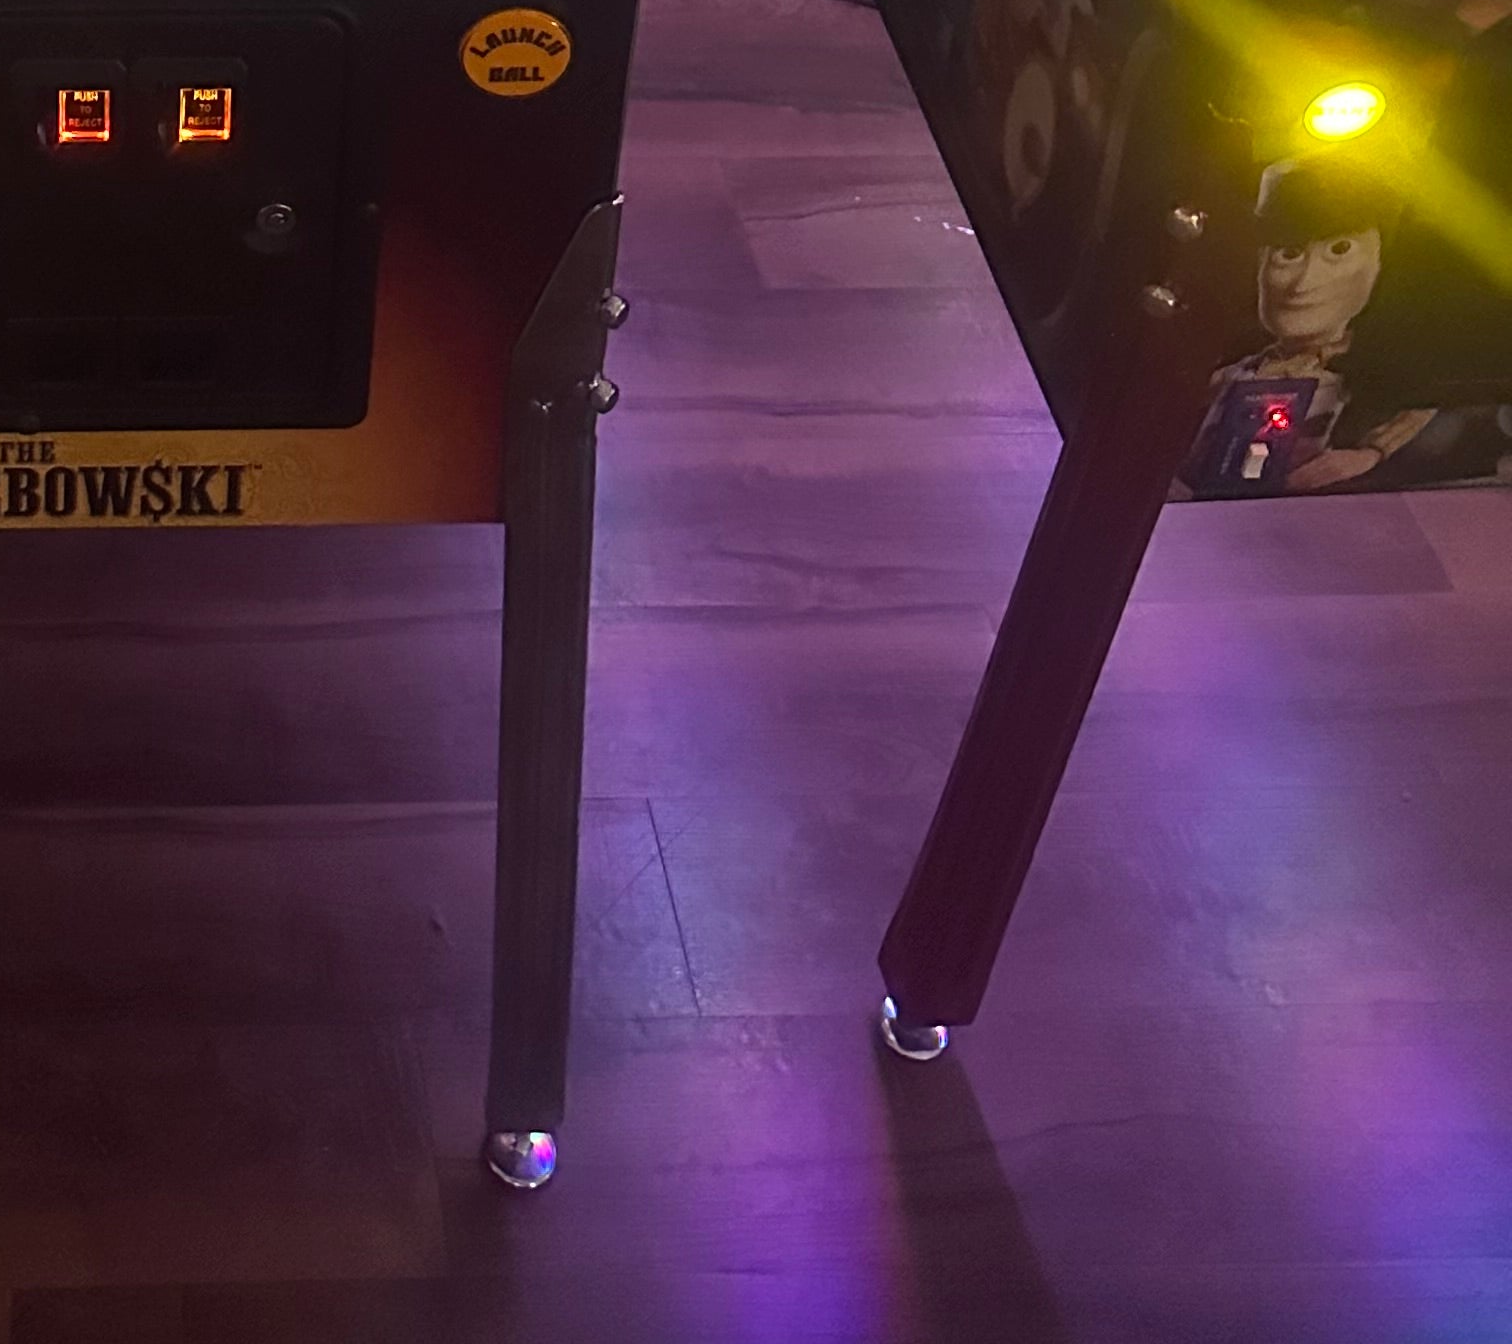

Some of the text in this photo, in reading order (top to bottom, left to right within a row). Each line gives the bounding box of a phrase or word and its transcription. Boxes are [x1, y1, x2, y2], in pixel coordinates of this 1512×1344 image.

[469, 27, 567, 59] LAUNCH
[488, 66, 545, 83] BALL
[73, 90, 99, 102] PUSH
[193, 89, 219, 101] PUSH
[79, 105, 93, 114] TO
[199, 103, 212, 113] TO
[68, 118, 103, 127] REJECT
[187, 116, 223, 126] REJECT
